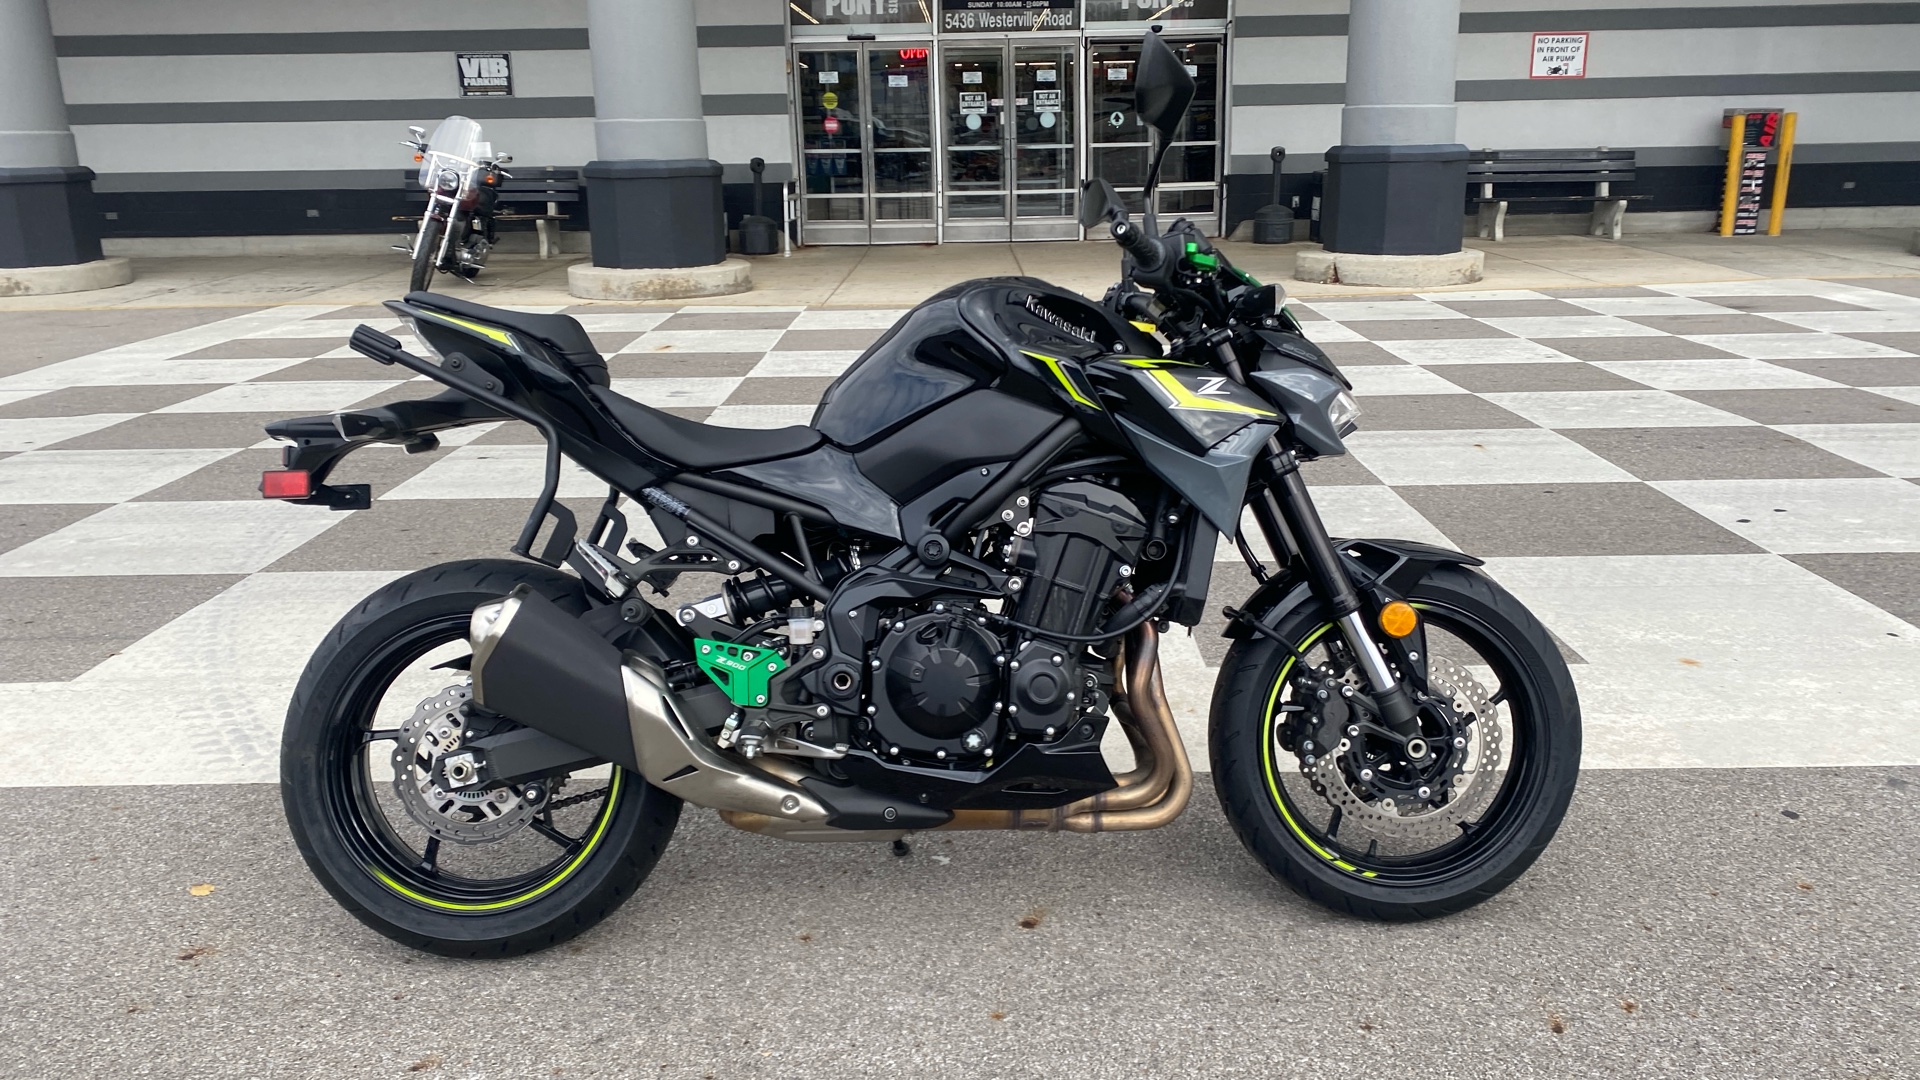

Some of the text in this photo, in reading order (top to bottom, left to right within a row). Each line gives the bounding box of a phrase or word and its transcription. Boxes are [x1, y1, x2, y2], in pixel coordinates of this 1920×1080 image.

[945, 10, 1072, 29] 5436 Westerville Road
[1551, 36, 1584, 44] PARKING
[458, 57, 509, 78] VIB
[463, 77, 508, 87] PARKING
[1759, 112, 1779, 147] AIR
[1025, 294, 1097, 343] Kawasaki
[715, 654, 747, 671] Z900
